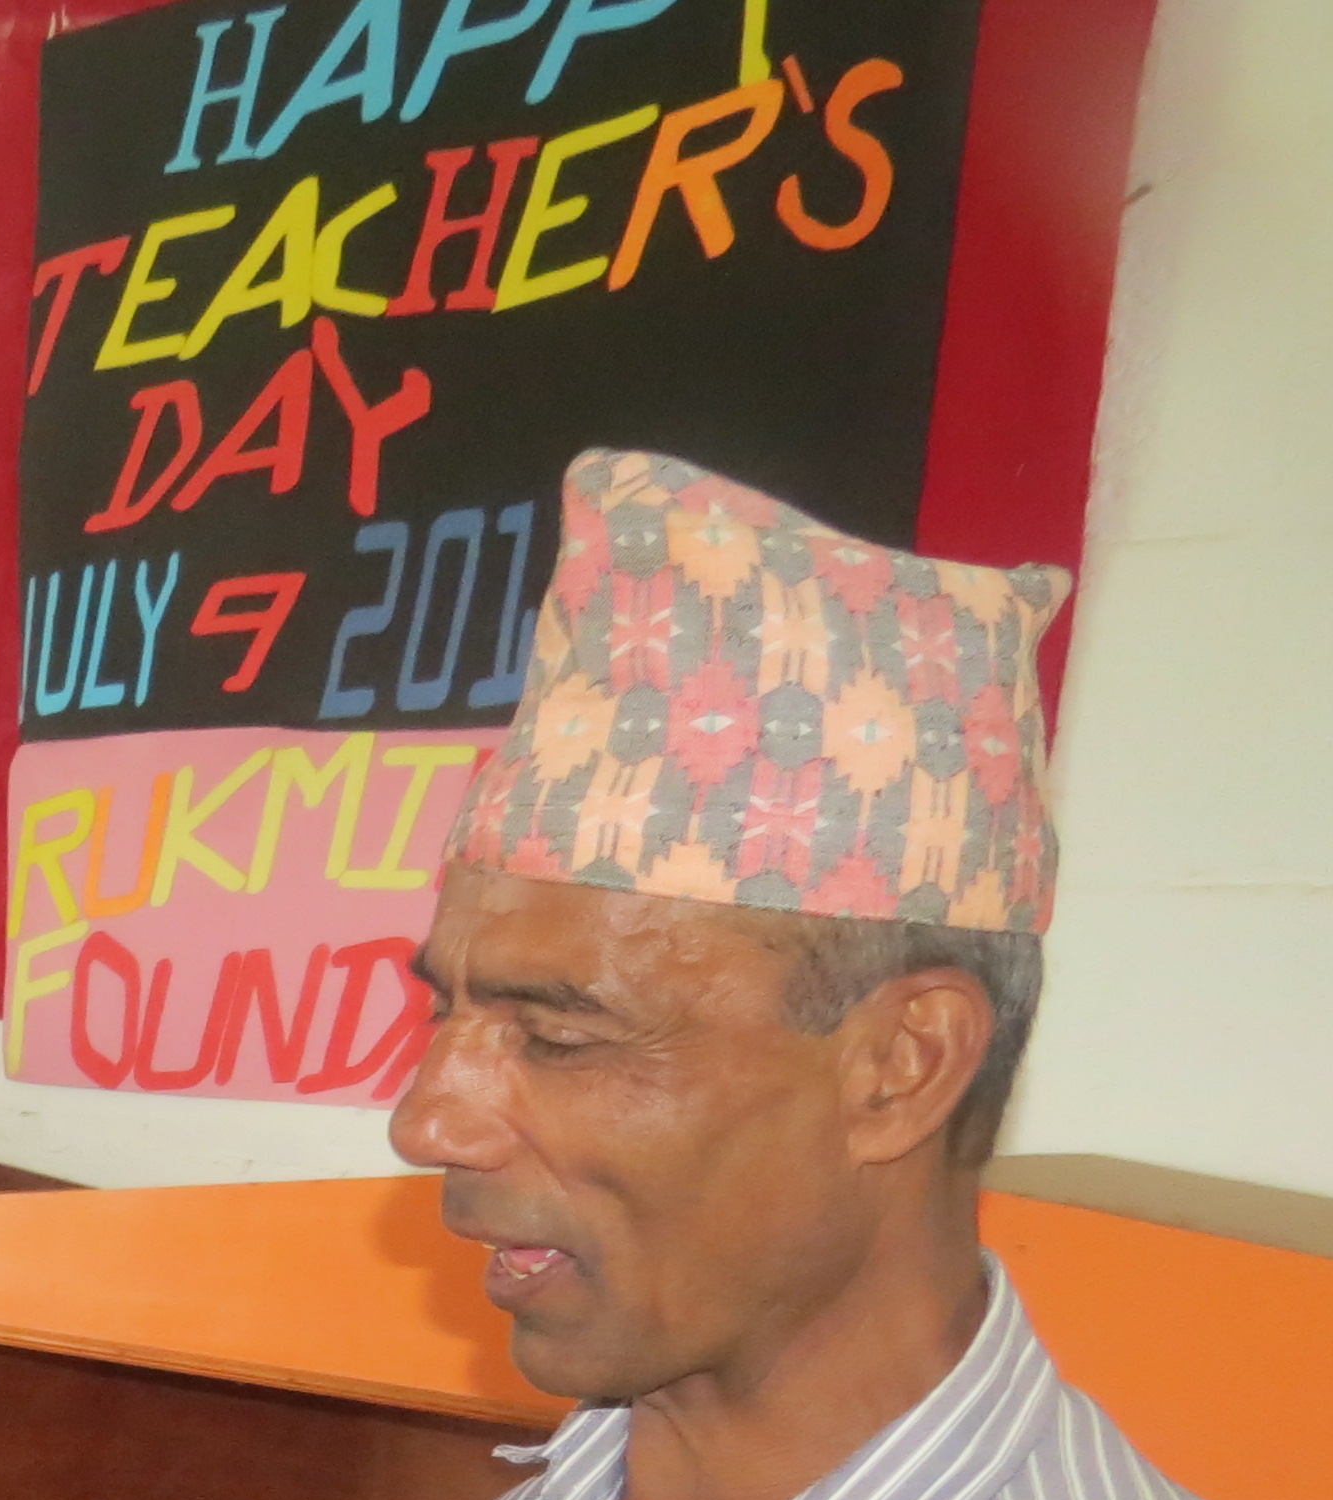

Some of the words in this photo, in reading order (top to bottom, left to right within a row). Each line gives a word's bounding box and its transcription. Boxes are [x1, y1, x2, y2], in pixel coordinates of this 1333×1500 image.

[27, 56, 903, 396] TEACHER'S
[85, 318, 430, 533] DAY
[190, 571, 307, 693] 9
[6, 731, 495, 939] RUKMI
